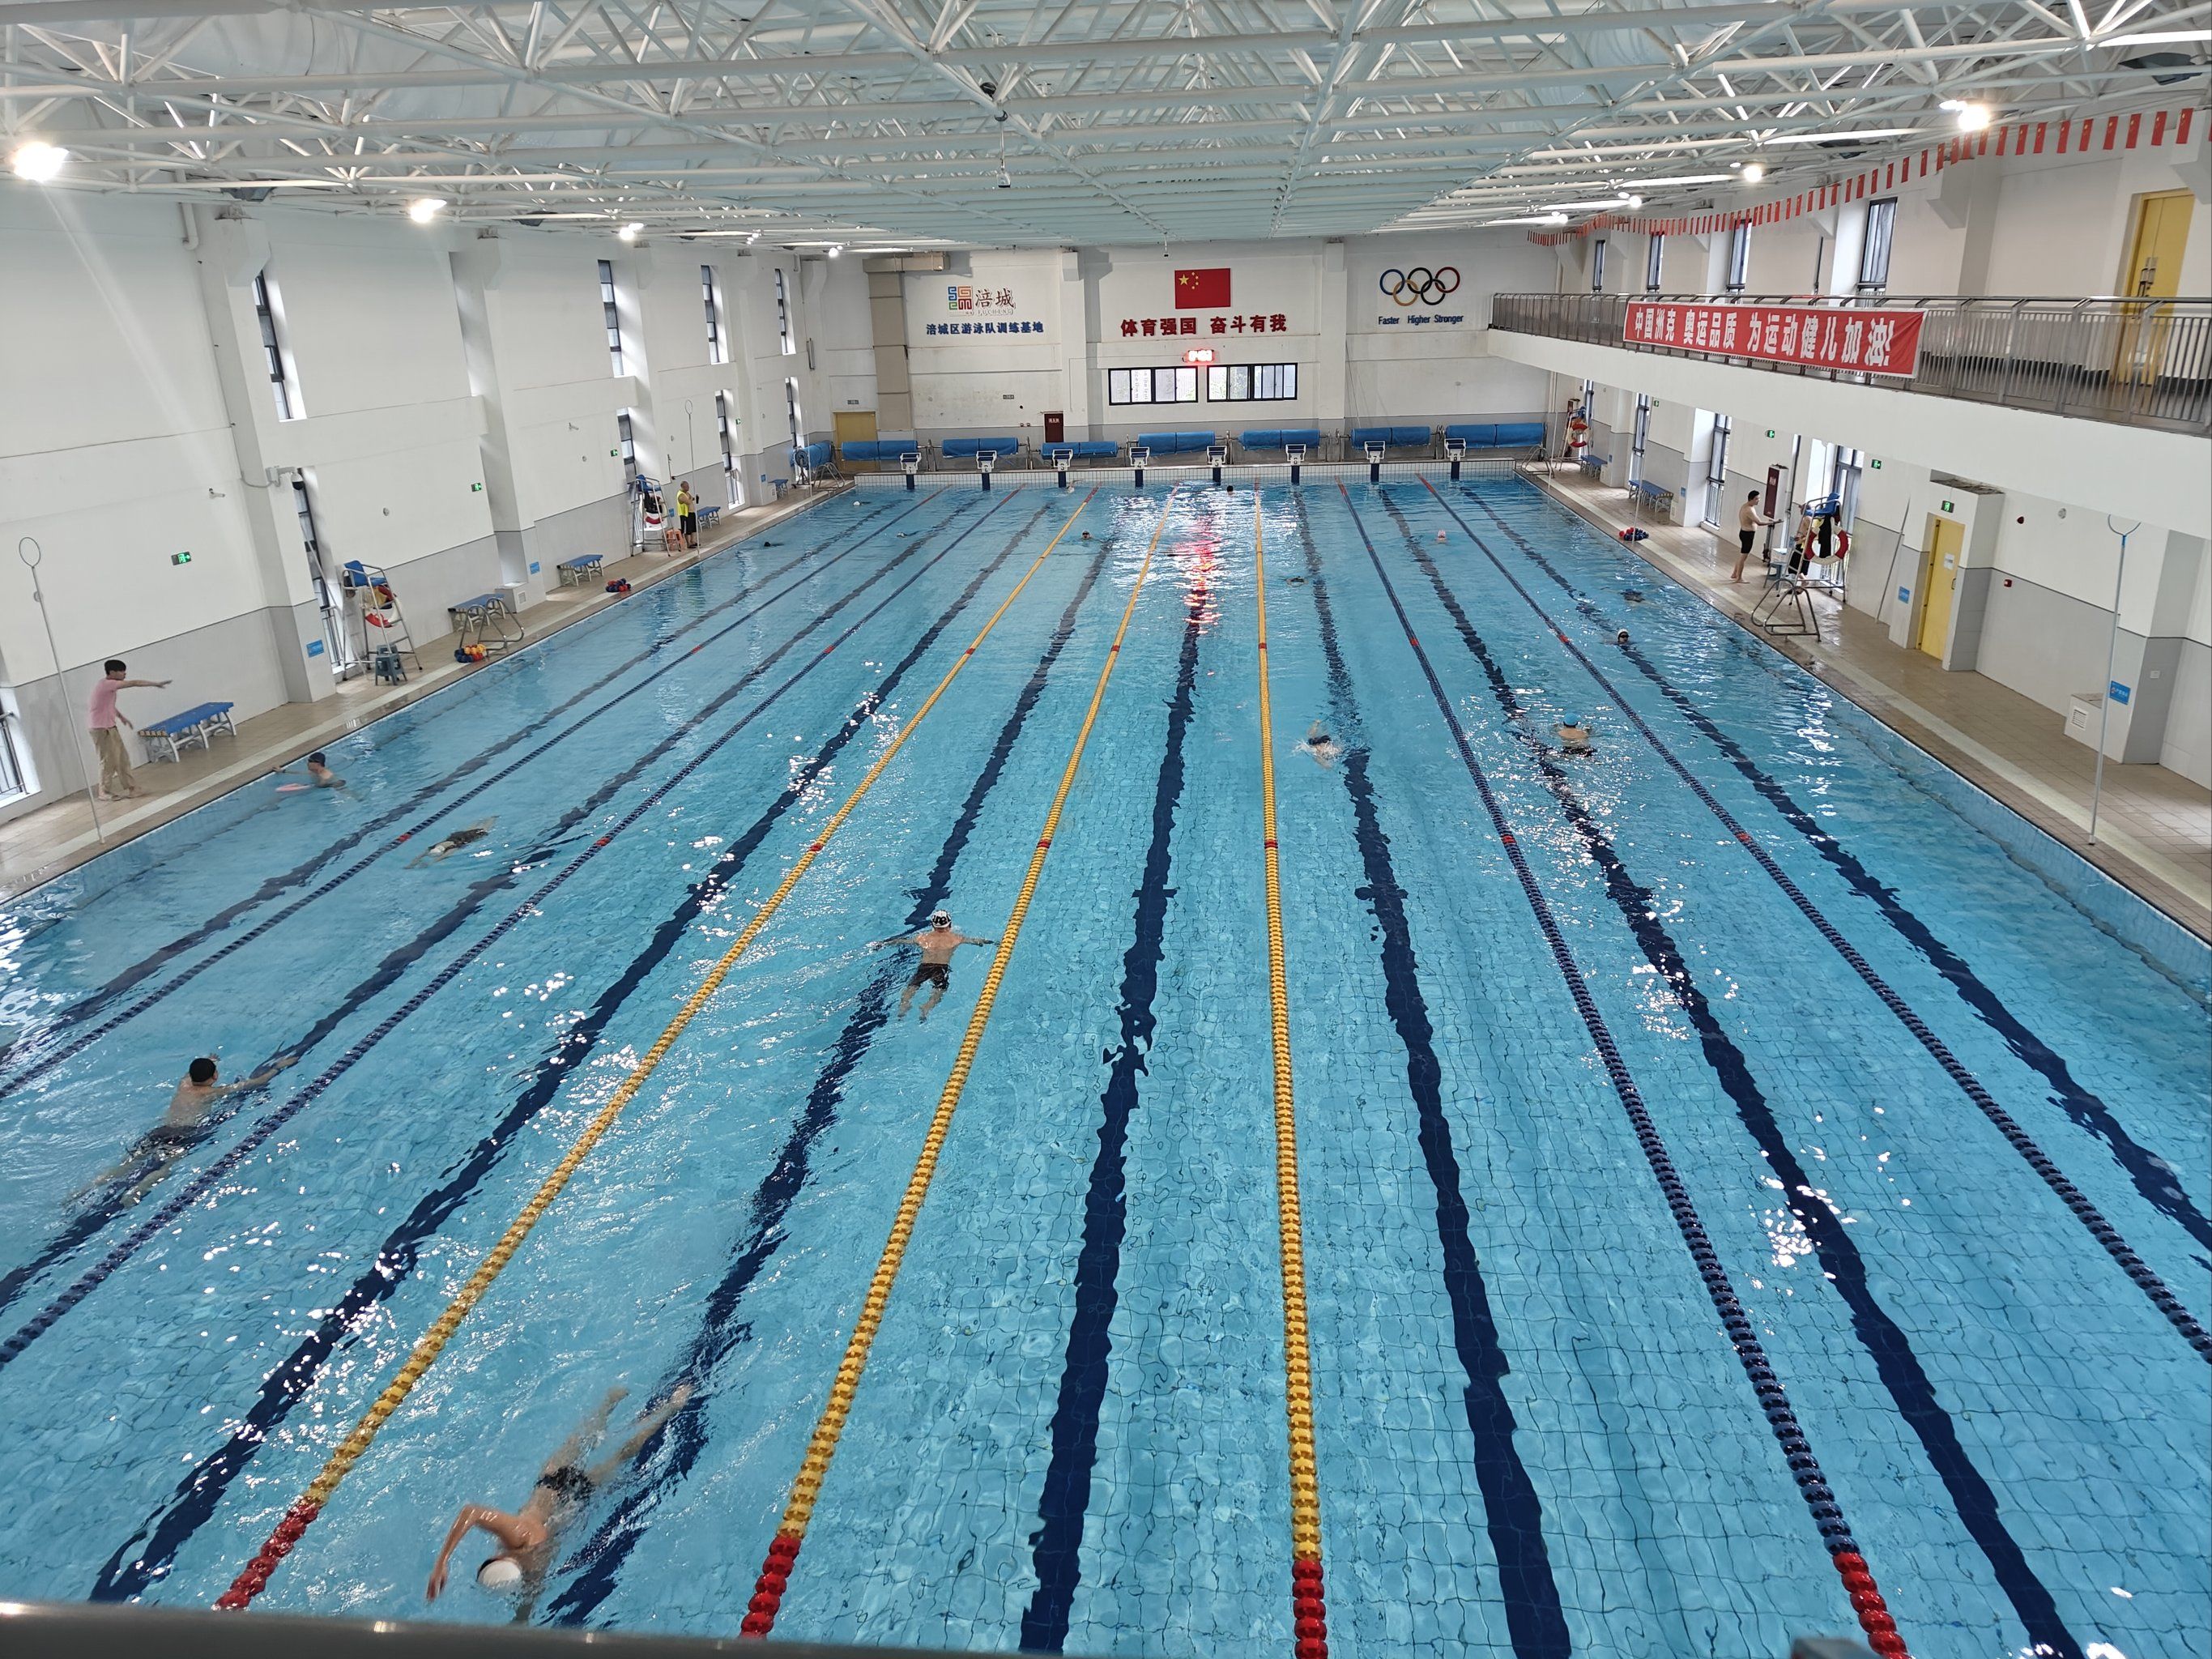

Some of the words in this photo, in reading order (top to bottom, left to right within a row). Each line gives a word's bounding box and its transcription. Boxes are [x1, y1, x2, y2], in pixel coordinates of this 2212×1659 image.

[975, 288, 1015, 309] 涪城
[926, 322, 1044, 335] 涪城区游泳队训练基地
[1120, 317, 1196, 337] 体育强国
[1210, 313, 1287, 335] 奋斗有我
[1378, 316, 1400, 325] Faster
[1407, 314, 1431, 326] Higher
[1434, 313, 1464, 325] Stronger
[1683, 309, 1737, 350] 奥运品质
